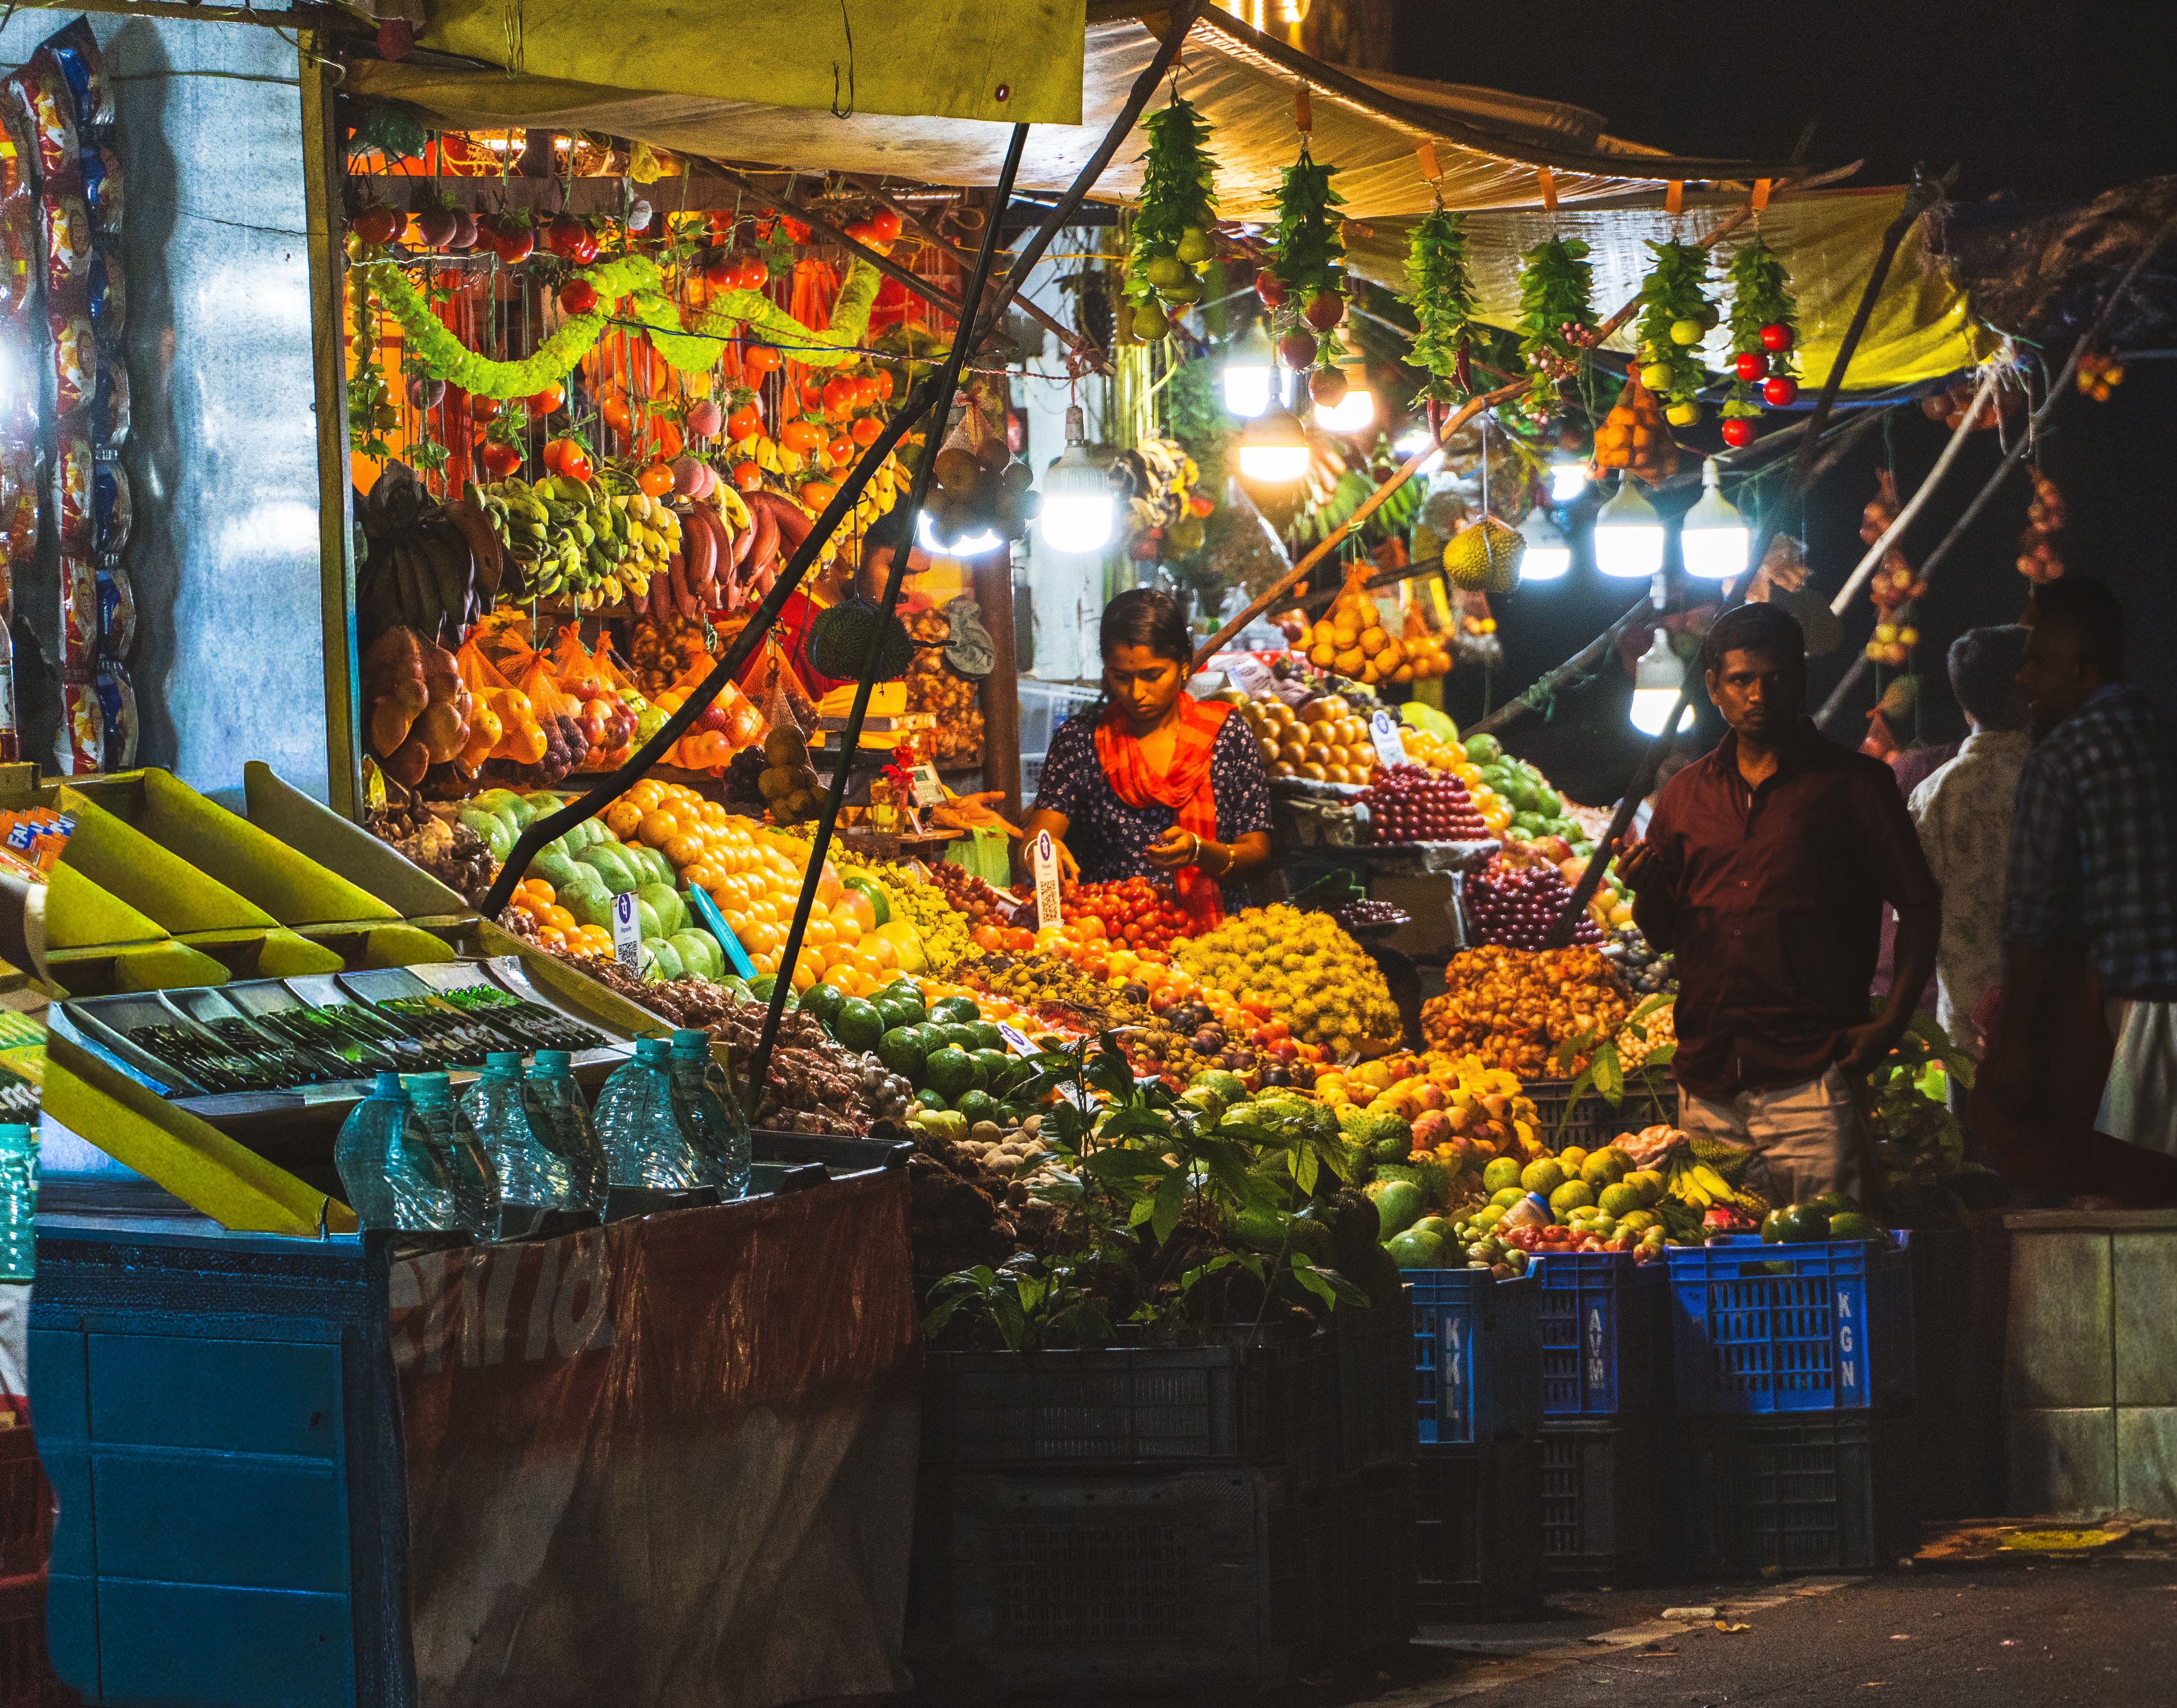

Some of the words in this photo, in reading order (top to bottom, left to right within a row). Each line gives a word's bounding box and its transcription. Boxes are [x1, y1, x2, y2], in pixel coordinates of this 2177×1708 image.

[1446, 1318, 1460, 1419] KKL
[1589, 1309, 1603, 1381] AVM
[1838, 1292, 1854, 1387] KGN
